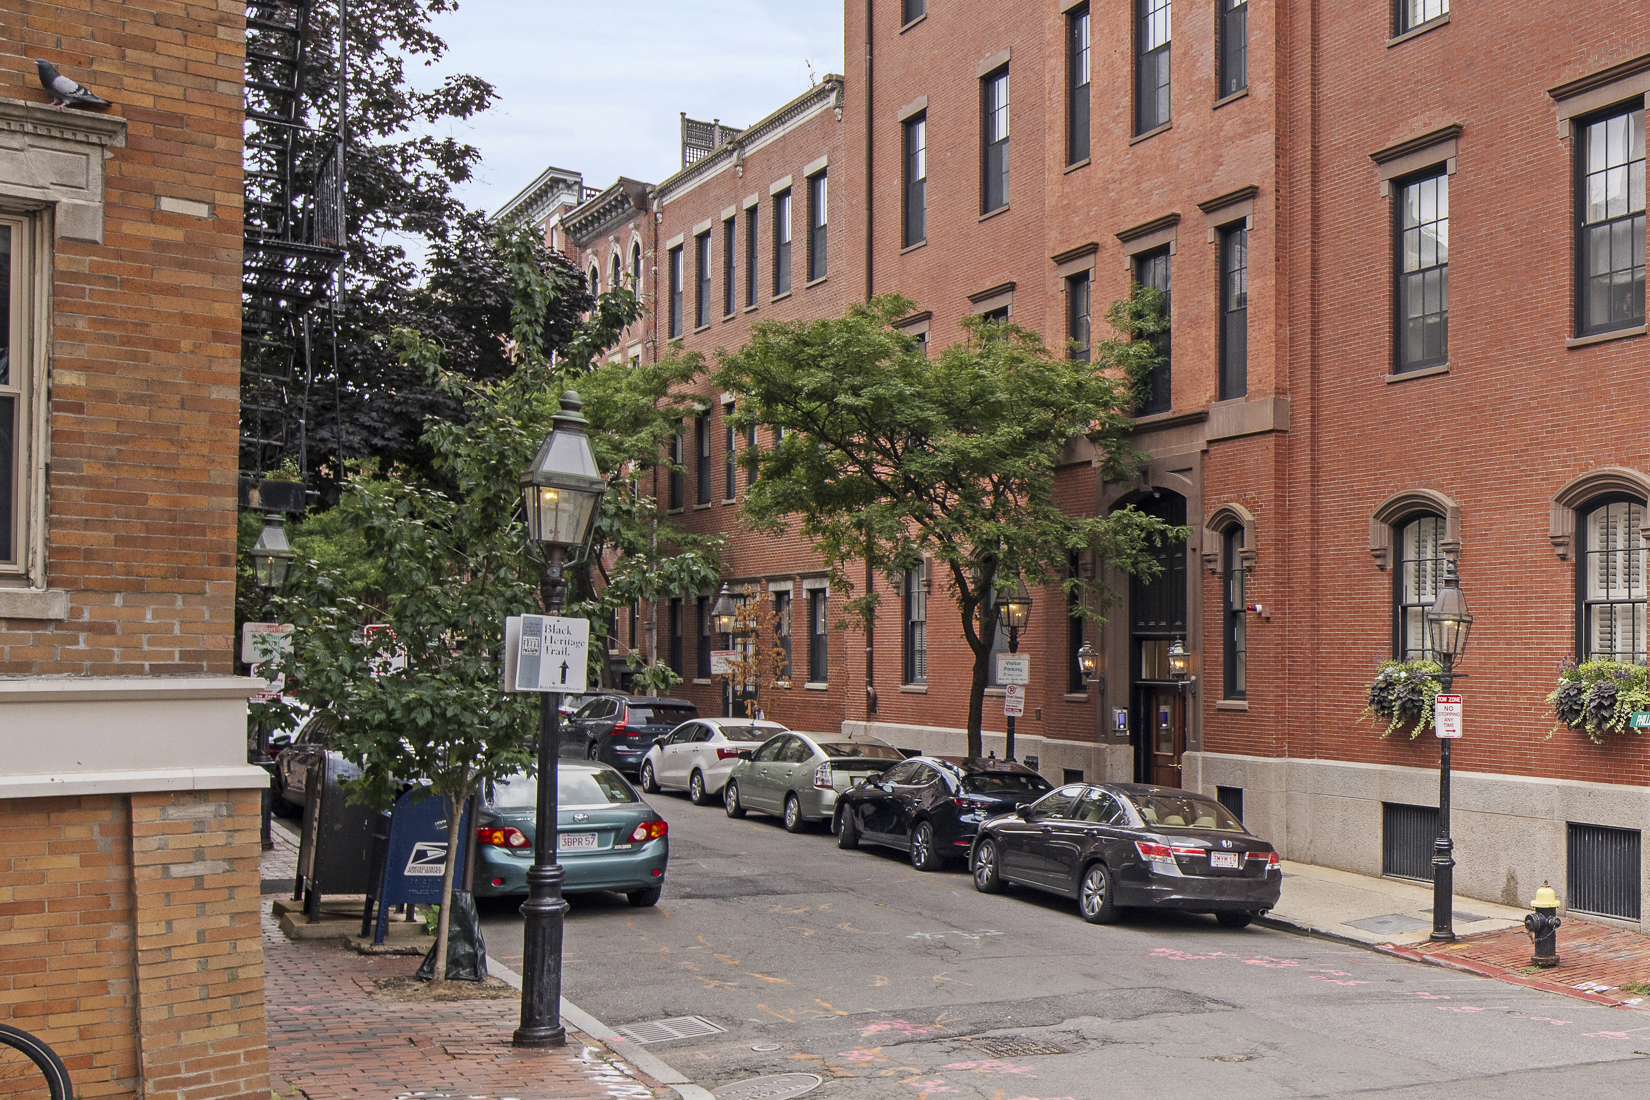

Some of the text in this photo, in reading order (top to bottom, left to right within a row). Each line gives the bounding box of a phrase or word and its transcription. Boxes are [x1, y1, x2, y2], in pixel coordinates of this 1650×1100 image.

[544, 623, 572, 635] Black
[543, 635, 585, 649] Heritage
[562, 837, 596, 846] 3BPR 57
